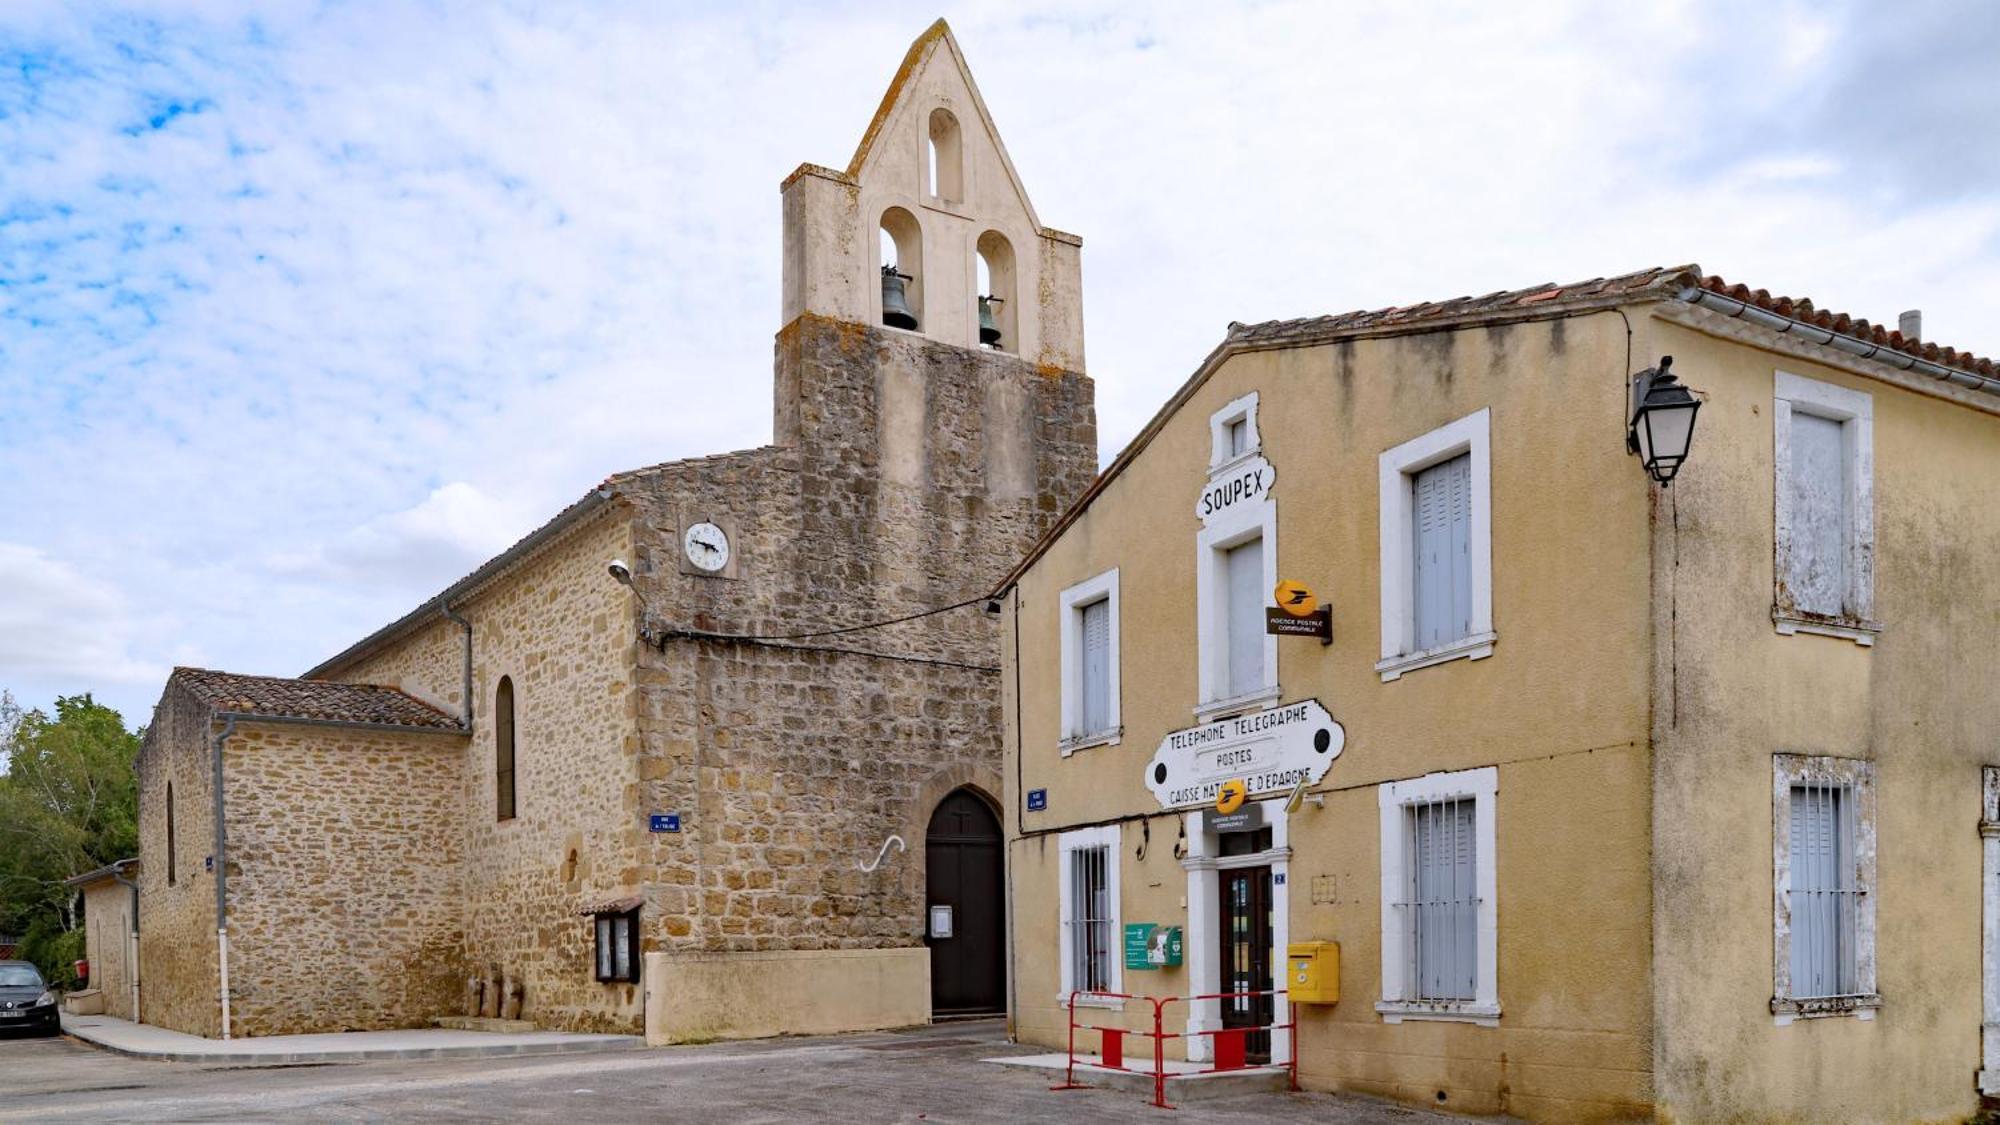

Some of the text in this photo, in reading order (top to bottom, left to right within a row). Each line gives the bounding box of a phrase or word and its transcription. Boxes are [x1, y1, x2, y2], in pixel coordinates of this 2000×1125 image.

[1204, 468, 1262, 515] SOUPEX
[1270, 617, 1324, 627] AGENCE POSTALE
[1171, 705, 1308, 750] TELEPHONE TELEGRAPHE
[1216, 748, 1252, 767] POSTES
[1170, 785, 1199, 804] CAISSE
